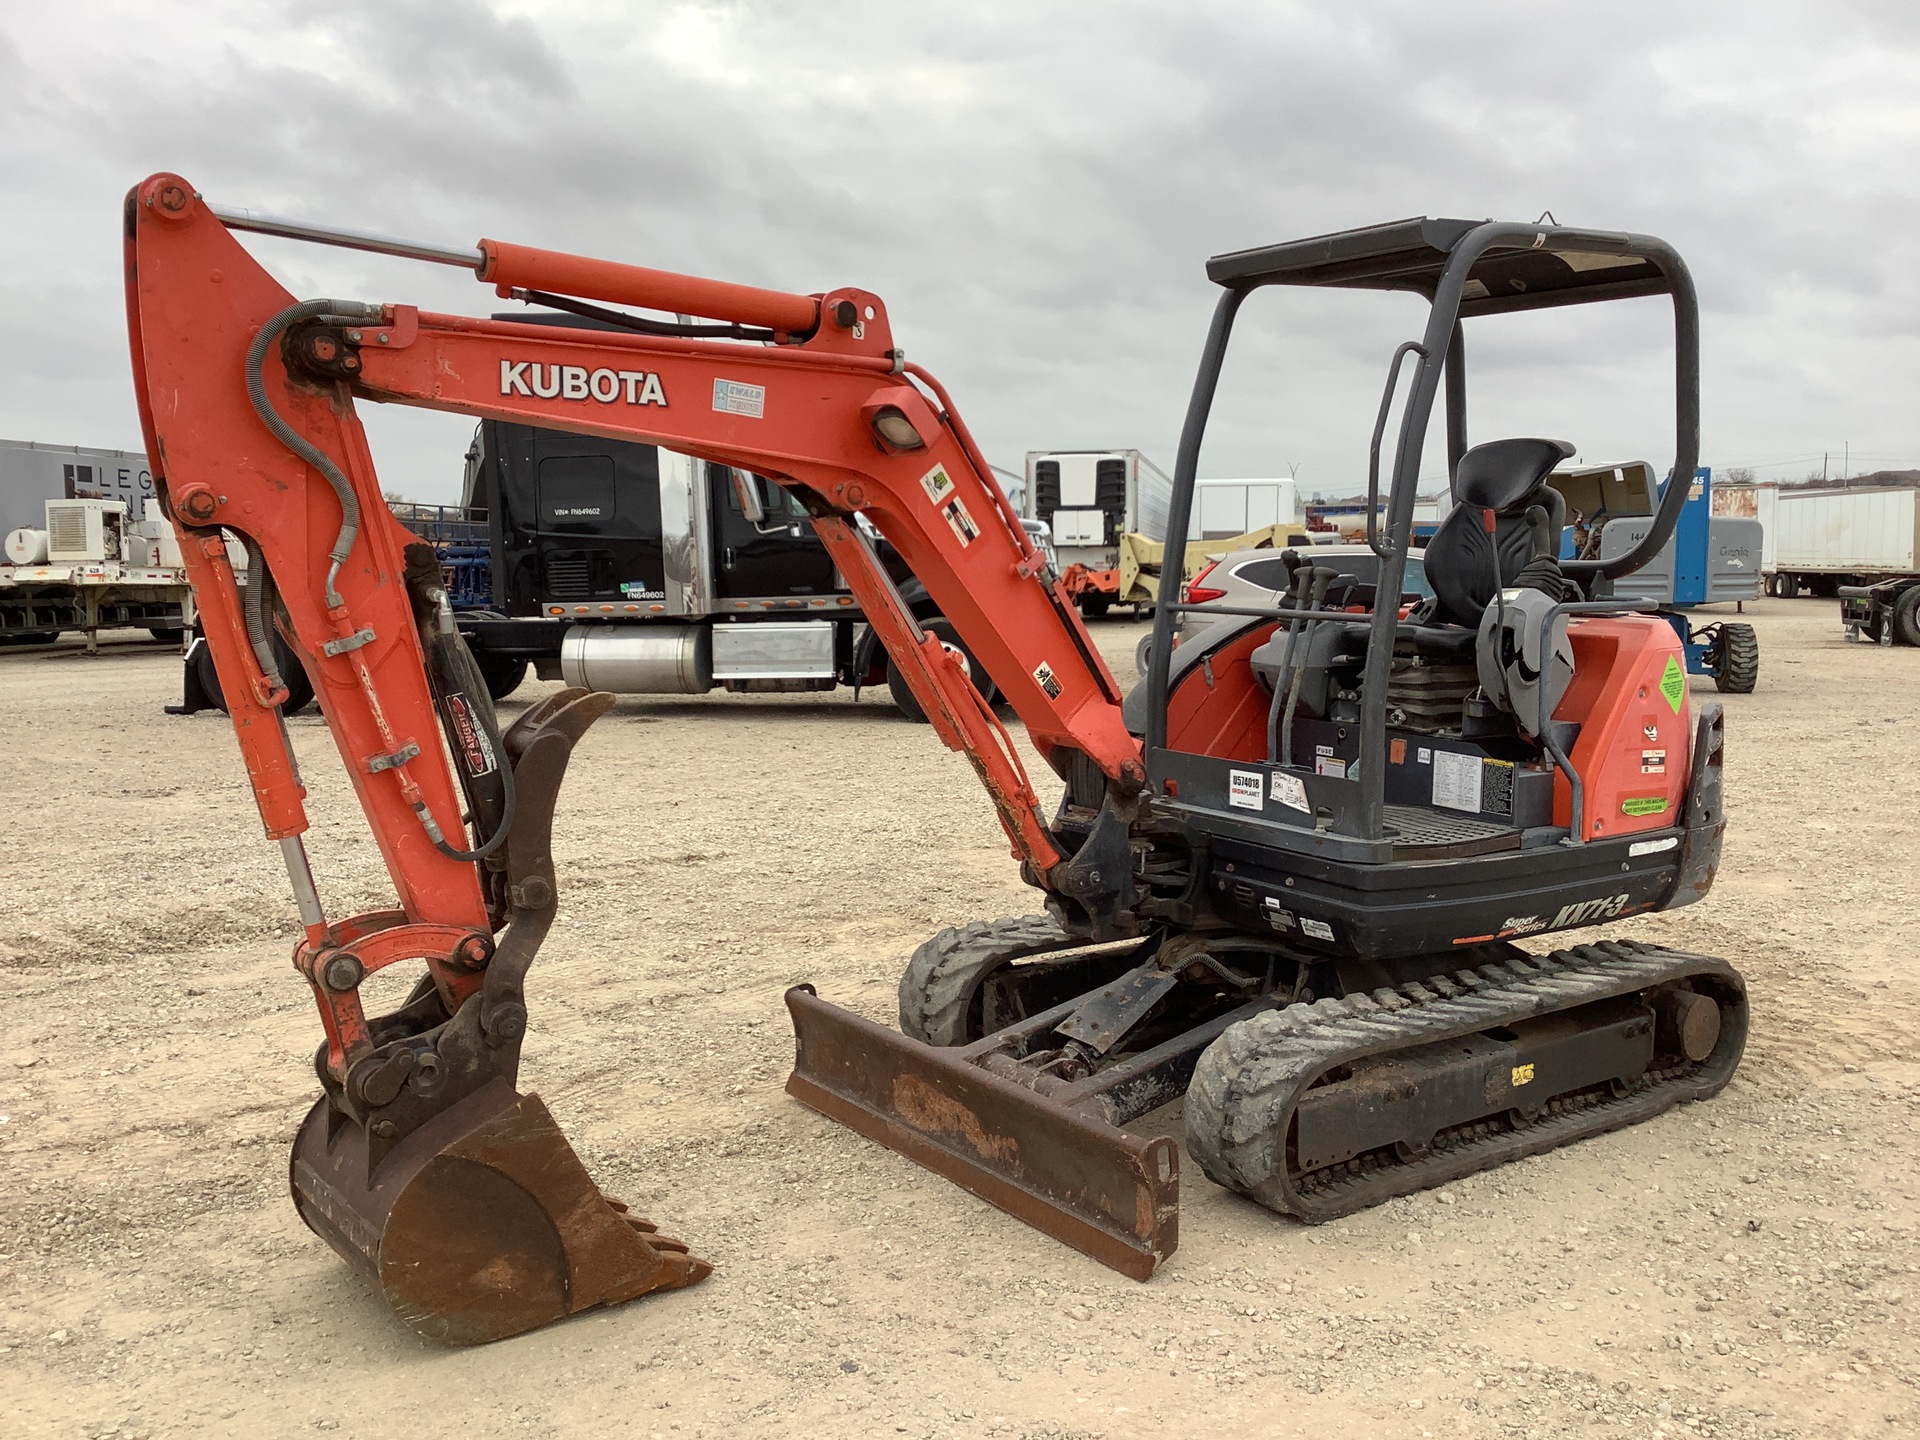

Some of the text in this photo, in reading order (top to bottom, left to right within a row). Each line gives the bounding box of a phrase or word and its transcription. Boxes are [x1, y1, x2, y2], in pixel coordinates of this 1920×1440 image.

[501, 360, 667, 406] KUBOTA
[729, 385, 761, 399] EWALD
[571, 508, 600, 516] FN649602
[1719, 546, 1749, 557] Genie
[627, 591, 664, 599] FN649602
[1317, 747, 1332, 755] FUSE
[1233, 775, 1260, 789] U574018
[1231, 787, 1260, 798] IRONPLANET
[1548, 893, 1630, 930] KX71-3
[1502, 914, 1539, 930] Super
[1514, 920, 1548, 935] Series
